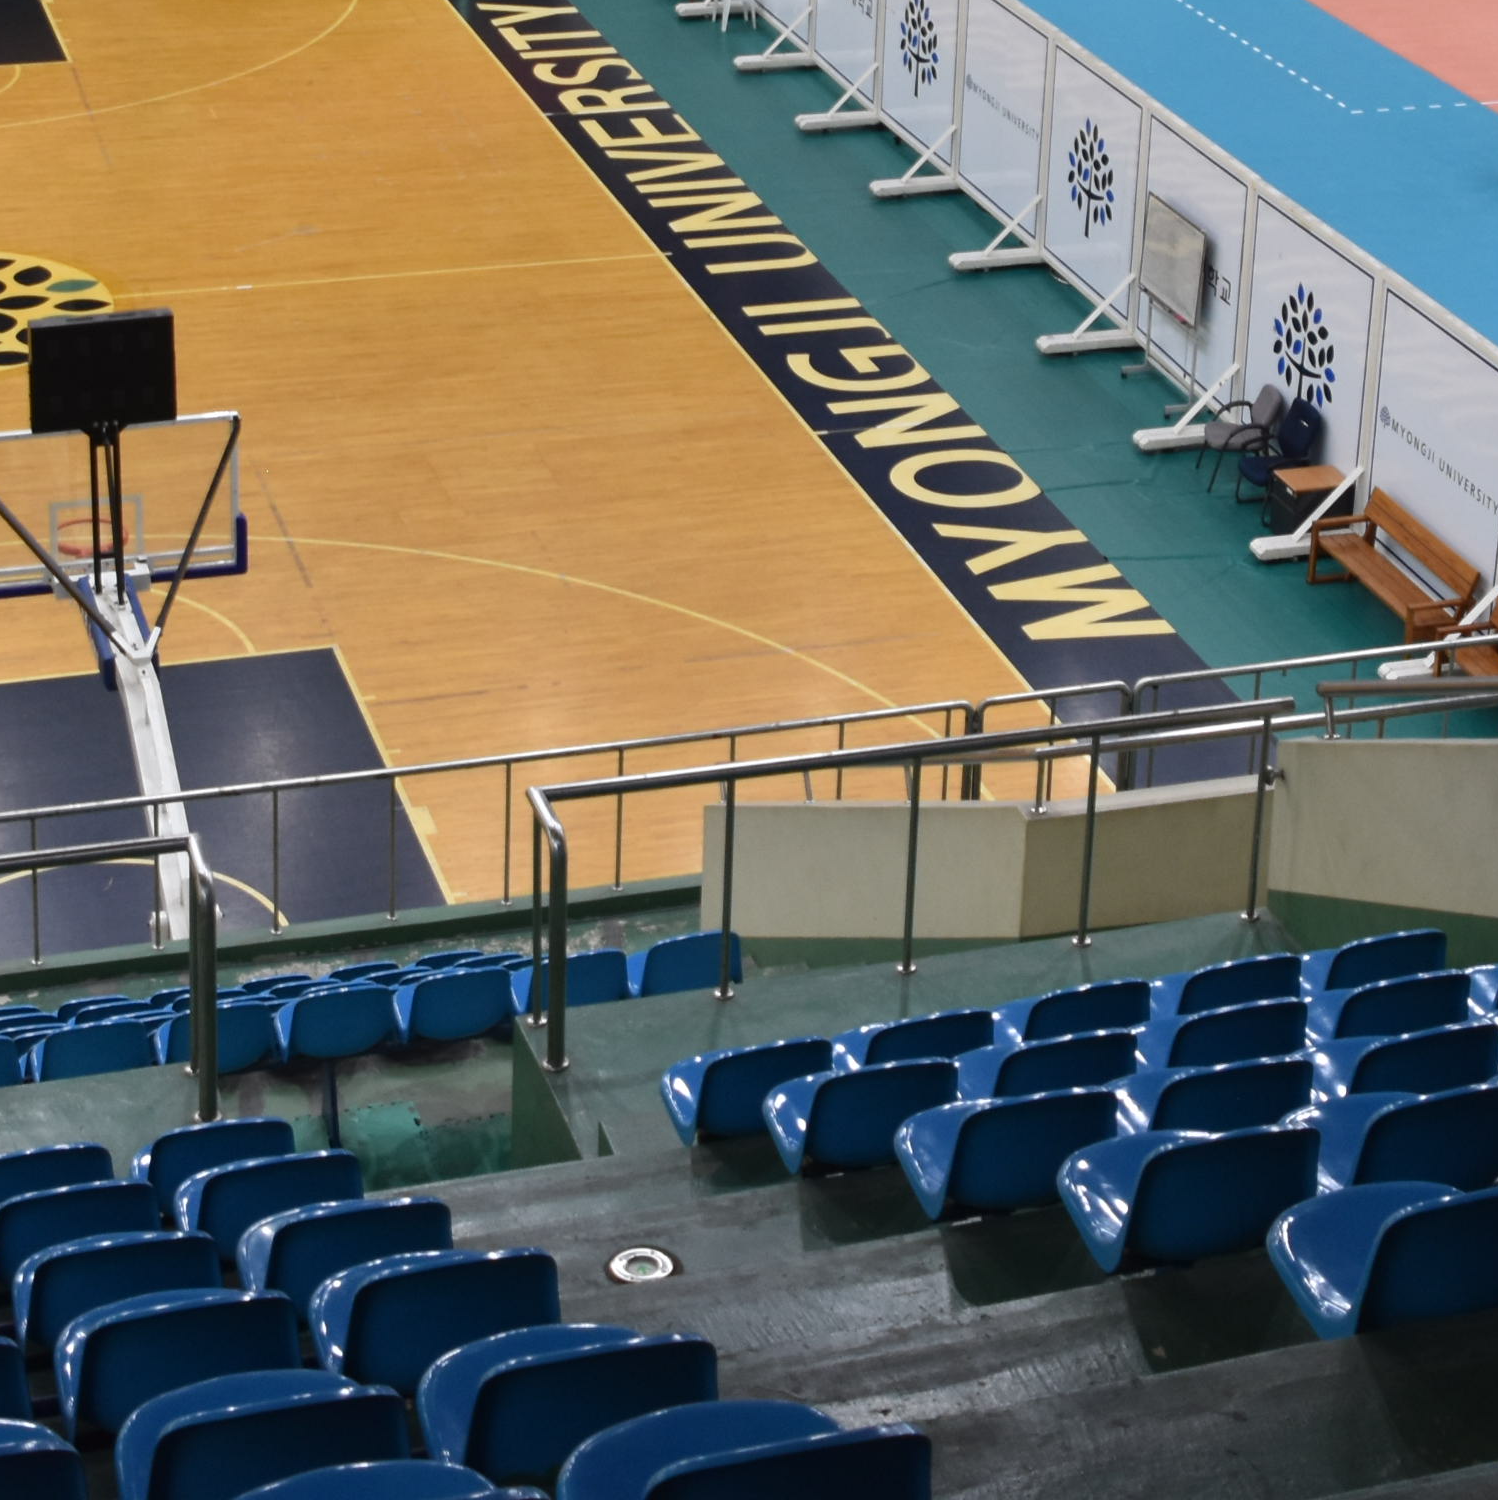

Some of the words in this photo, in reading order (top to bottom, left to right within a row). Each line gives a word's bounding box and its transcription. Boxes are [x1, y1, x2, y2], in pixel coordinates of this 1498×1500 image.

[476, 2, 819, 275] UNIVERSITY
[741, 297, 1176, 640] MYONGJI
[1391, 418, 1435, 463] MYONGJI
[1438, 457, 1498, 515] UNIVERSITY
